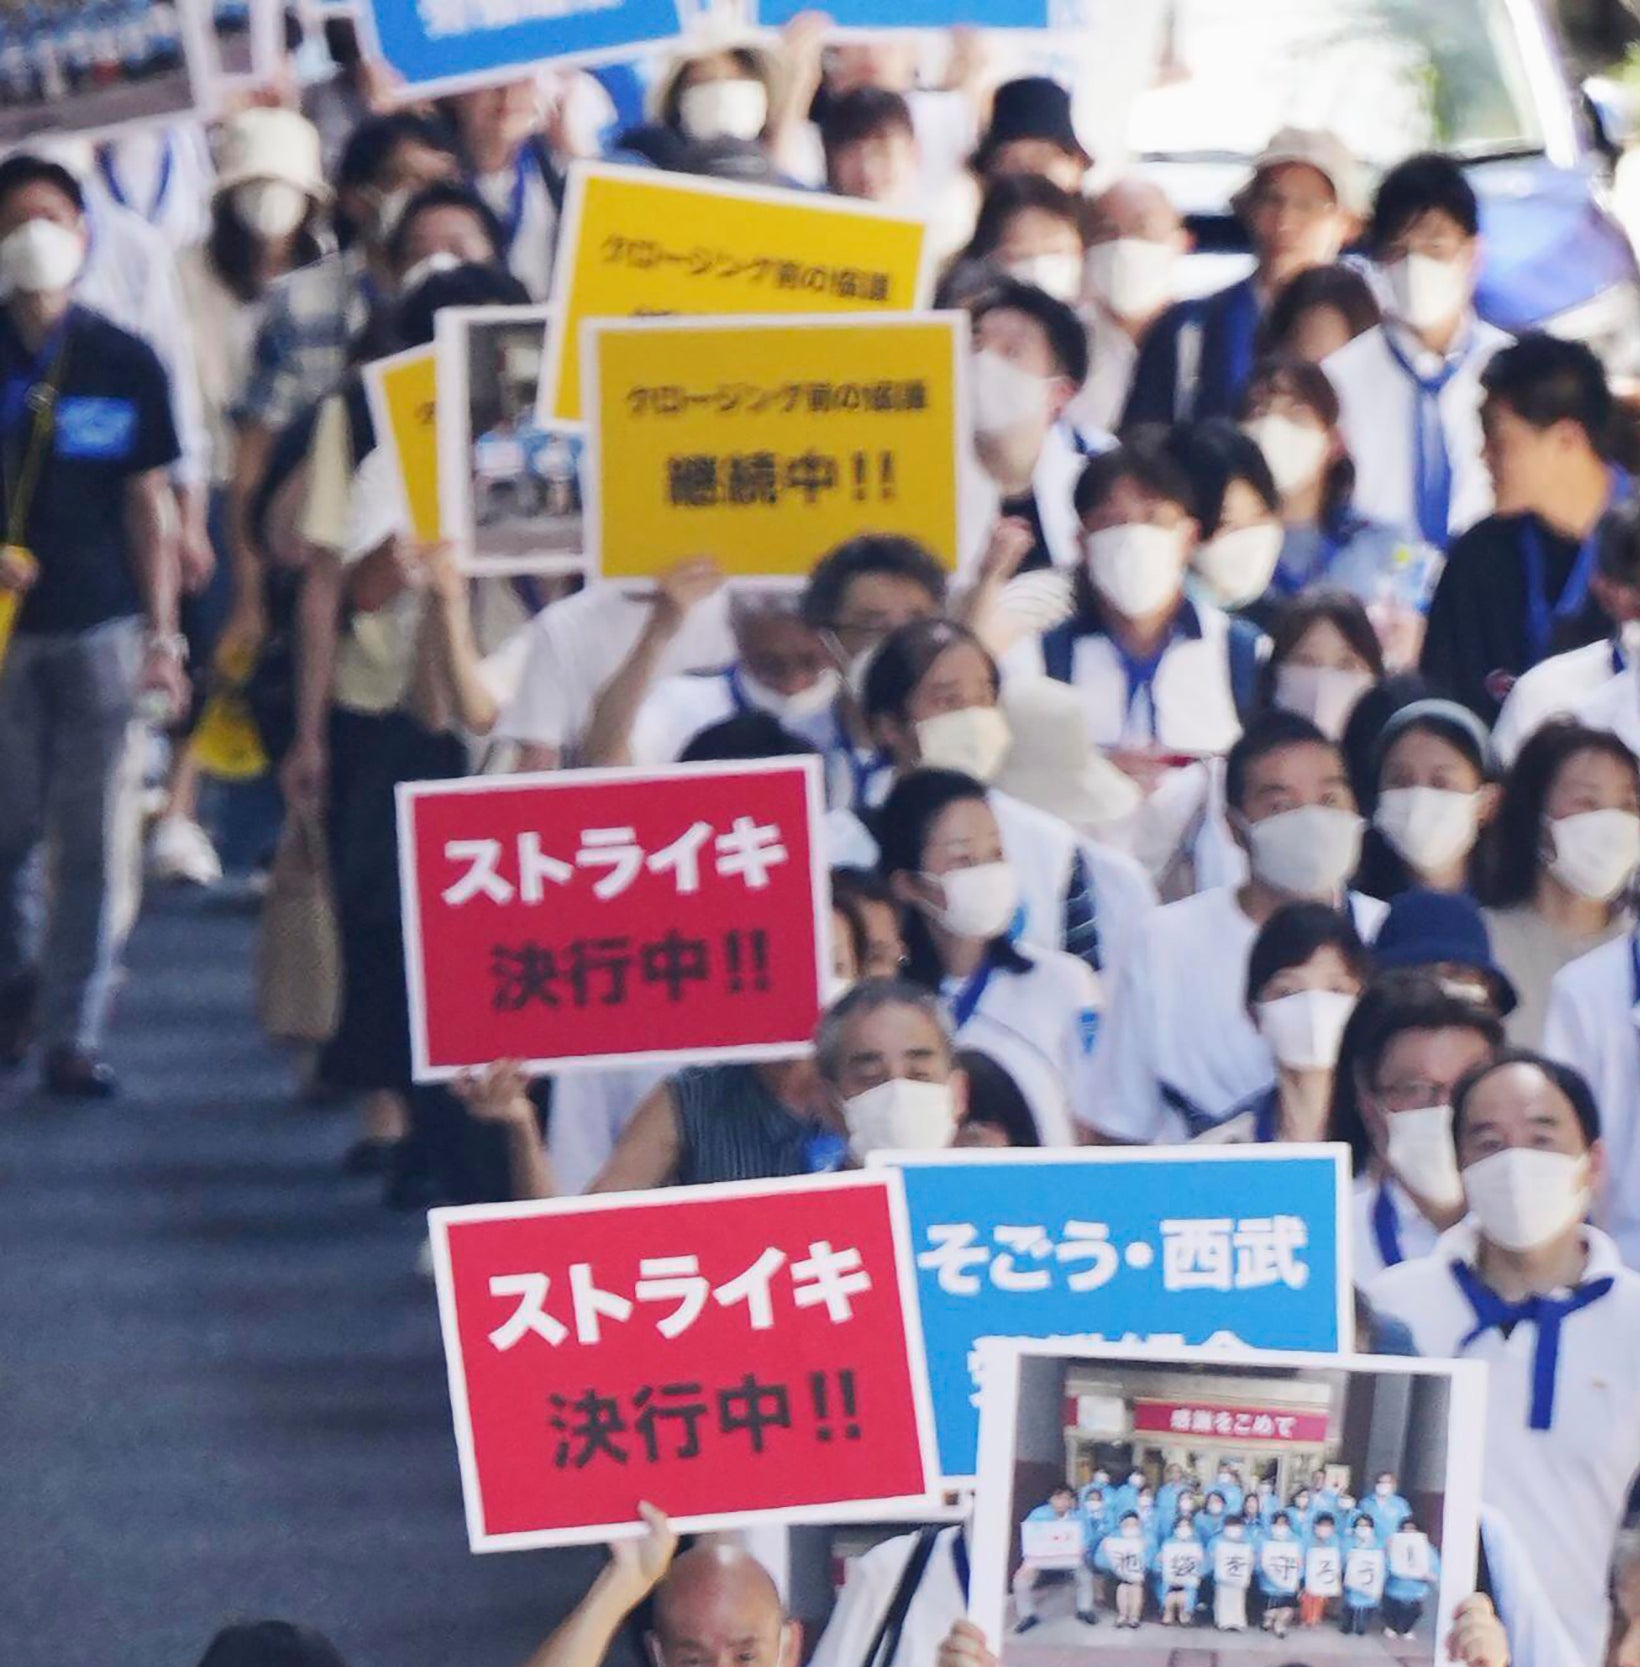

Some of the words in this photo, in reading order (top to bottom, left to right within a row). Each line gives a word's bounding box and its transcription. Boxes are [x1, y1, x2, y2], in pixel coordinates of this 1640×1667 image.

[442, 816, 788, 906] ストライキ
[490, 929, 771, 1011] 決行中!!
[488, 1240, 871, 1351] ストライキ
[917, 1214, 1310, 1295] そごう・西武
[547, 1370, 861, 1471] 決行中!!
